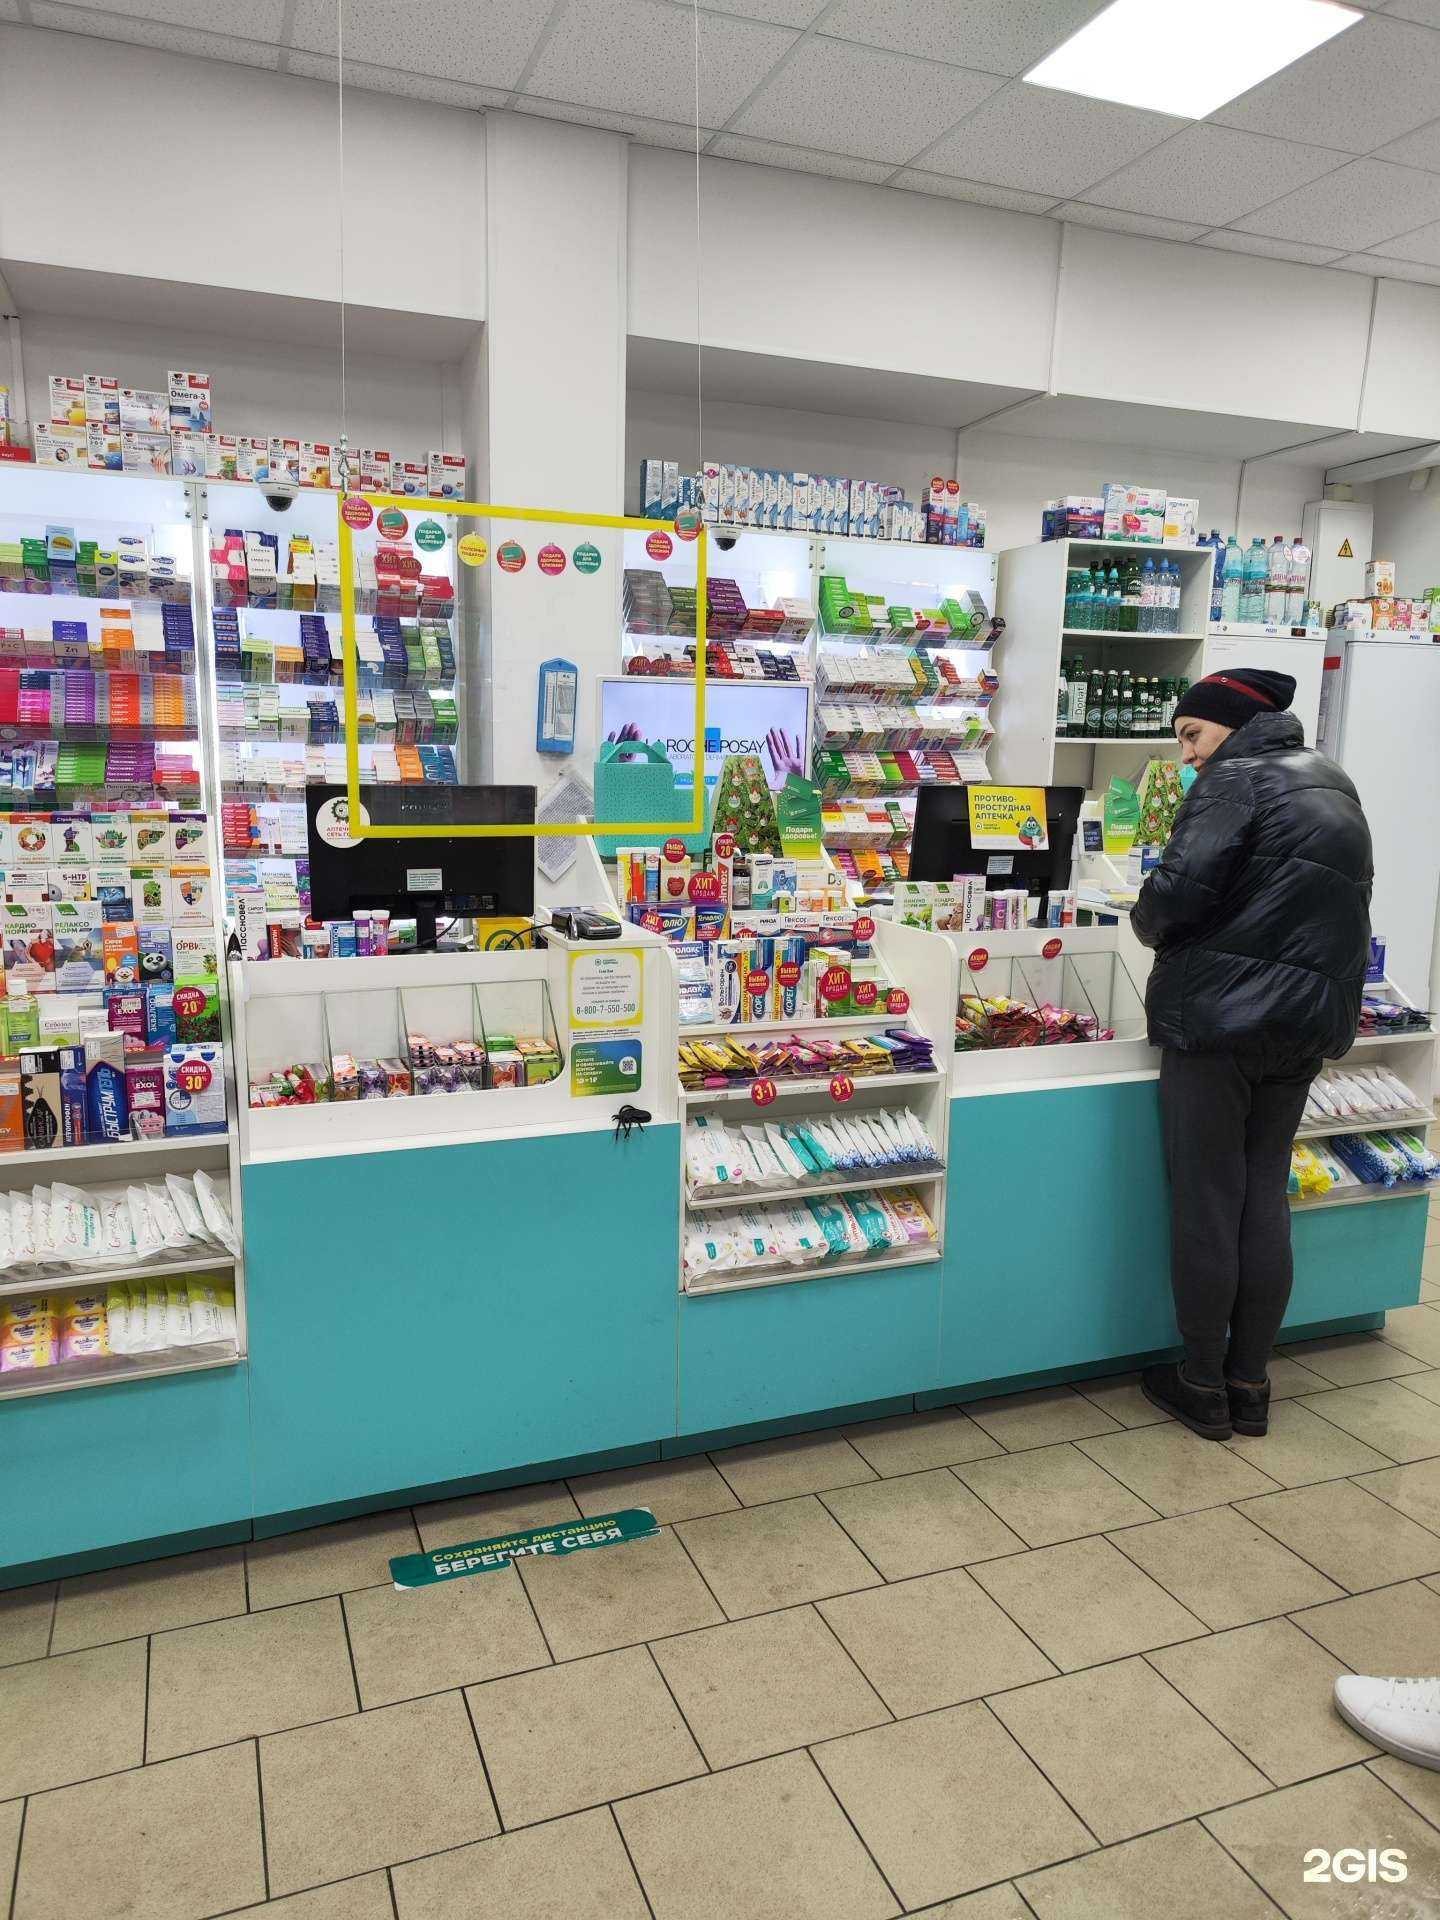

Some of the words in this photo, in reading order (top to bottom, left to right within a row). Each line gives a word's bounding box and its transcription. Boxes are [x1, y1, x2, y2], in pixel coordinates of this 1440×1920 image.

[170, 390, 206, 400] Омега-3
[382, 553, 396, 563] ХИТ
[402, 560, 416, 568] ХИТ
[1074, 686, 1086, 715] Donat
[720, 740, 765, 753] POSAY
[696, 878, 713, 889] ХИТ
[646, 914, 659, 925] ХИТ
[858, 920, 870, 928] ХИТ
[828, 972, 846, 985] ХИТ
[859, 984, 872, 994] ХИТ
[892, 994, 904, 1002] ХИТ
[432, 1537, 528, 1563] Сохраняйте
[532, 1520, 616, 1544] дистанцию
[435, 1541, 556, 1575] БЕРЕГИТЕ
[562, 1528, 623, 1549] СЕБЯ
